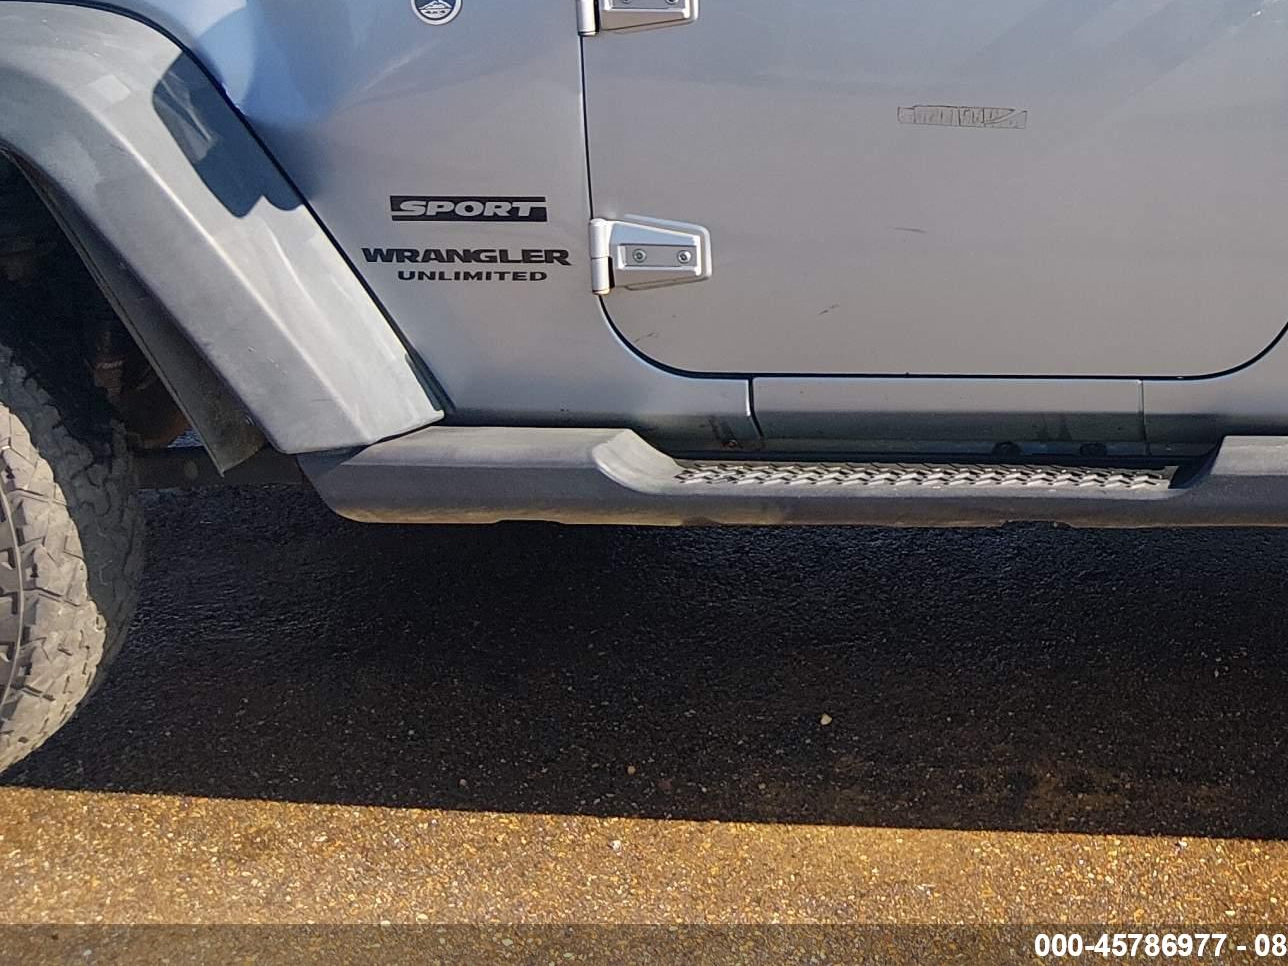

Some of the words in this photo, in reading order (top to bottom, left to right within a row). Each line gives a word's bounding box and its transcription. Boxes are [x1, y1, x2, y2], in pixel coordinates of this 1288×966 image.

[392, 199, 547, 218] SPORT
[361, 247, 572, 266] WRANGLER
[398, 270, 548, 282] UNLIMITED
